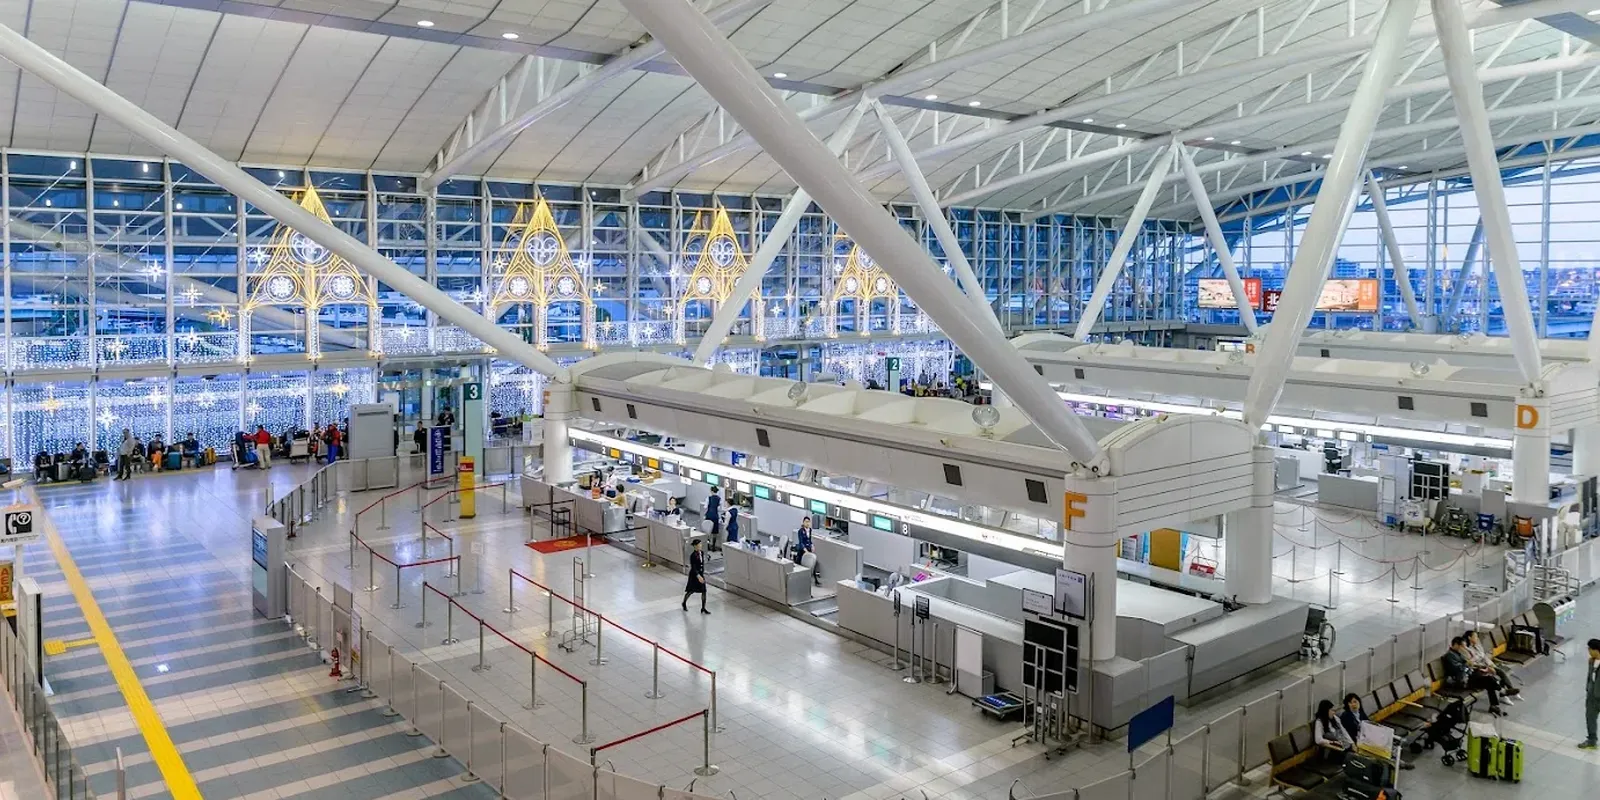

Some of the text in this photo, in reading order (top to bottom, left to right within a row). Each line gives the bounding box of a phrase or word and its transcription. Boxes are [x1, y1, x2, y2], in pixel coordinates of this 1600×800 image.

[892, 358, 898, 370] 2
[470, 384, 479, 399] 3
[1517, 404, 1539, 429] D
[601, 446, 607, 455] 2
[835, 506, 841, 517] 7
[1064, 491, 1088, 531] F
[902, 523, 909, 535] 8
